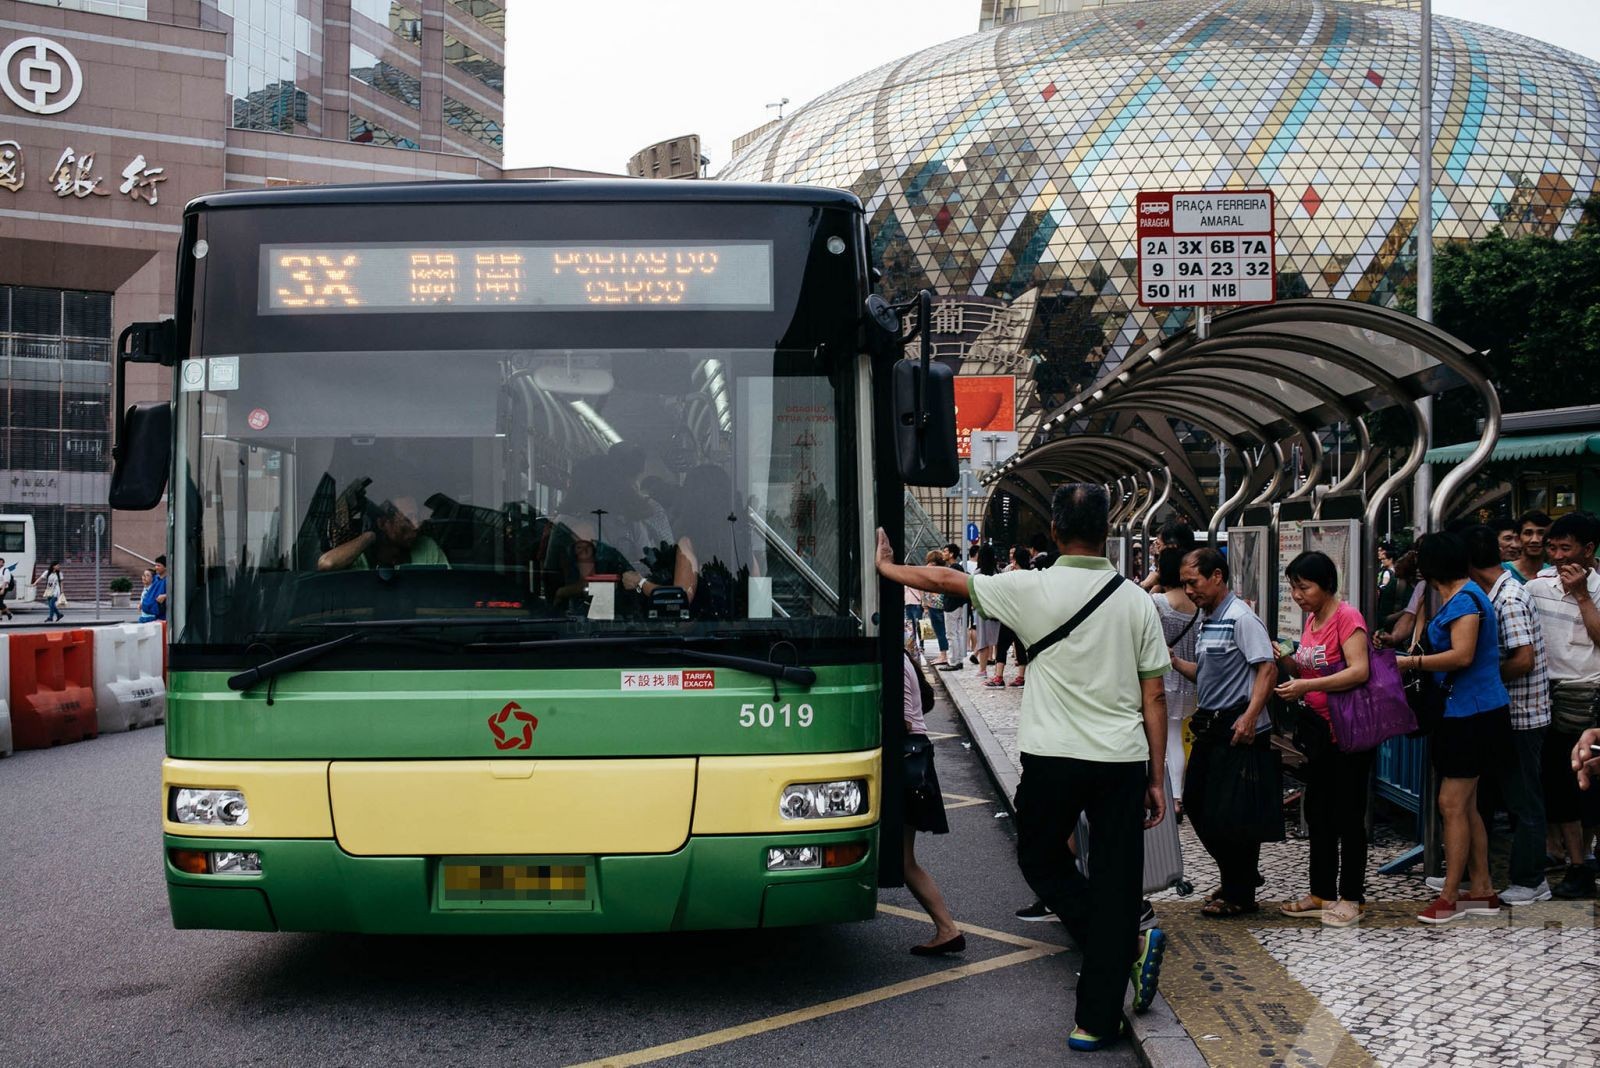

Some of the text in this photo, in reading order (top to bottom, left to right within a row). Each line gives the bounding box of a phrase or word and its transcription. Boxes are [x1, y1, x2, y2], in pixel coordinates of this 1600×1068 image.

[1176, 199, 1267, 213] PRAÇA FERREIRA
[1140, 218, 1170, 228] PARAGEM
[1200, 216, 1244, 227] AMARAL
[1147, 240, 1267, 255] 2A 3X 6B 7A
[1153, 262, 1269, 277] 9 9A 23 32
[279, 255, 359, 305] 3X
[1147, 284, 1237, 298] 50 H1 N1B
[624, 674, 679, 687] 不設找贖
[684, 680, 714, 688] EXACTA
[739, 703, 814, 728] 5019
